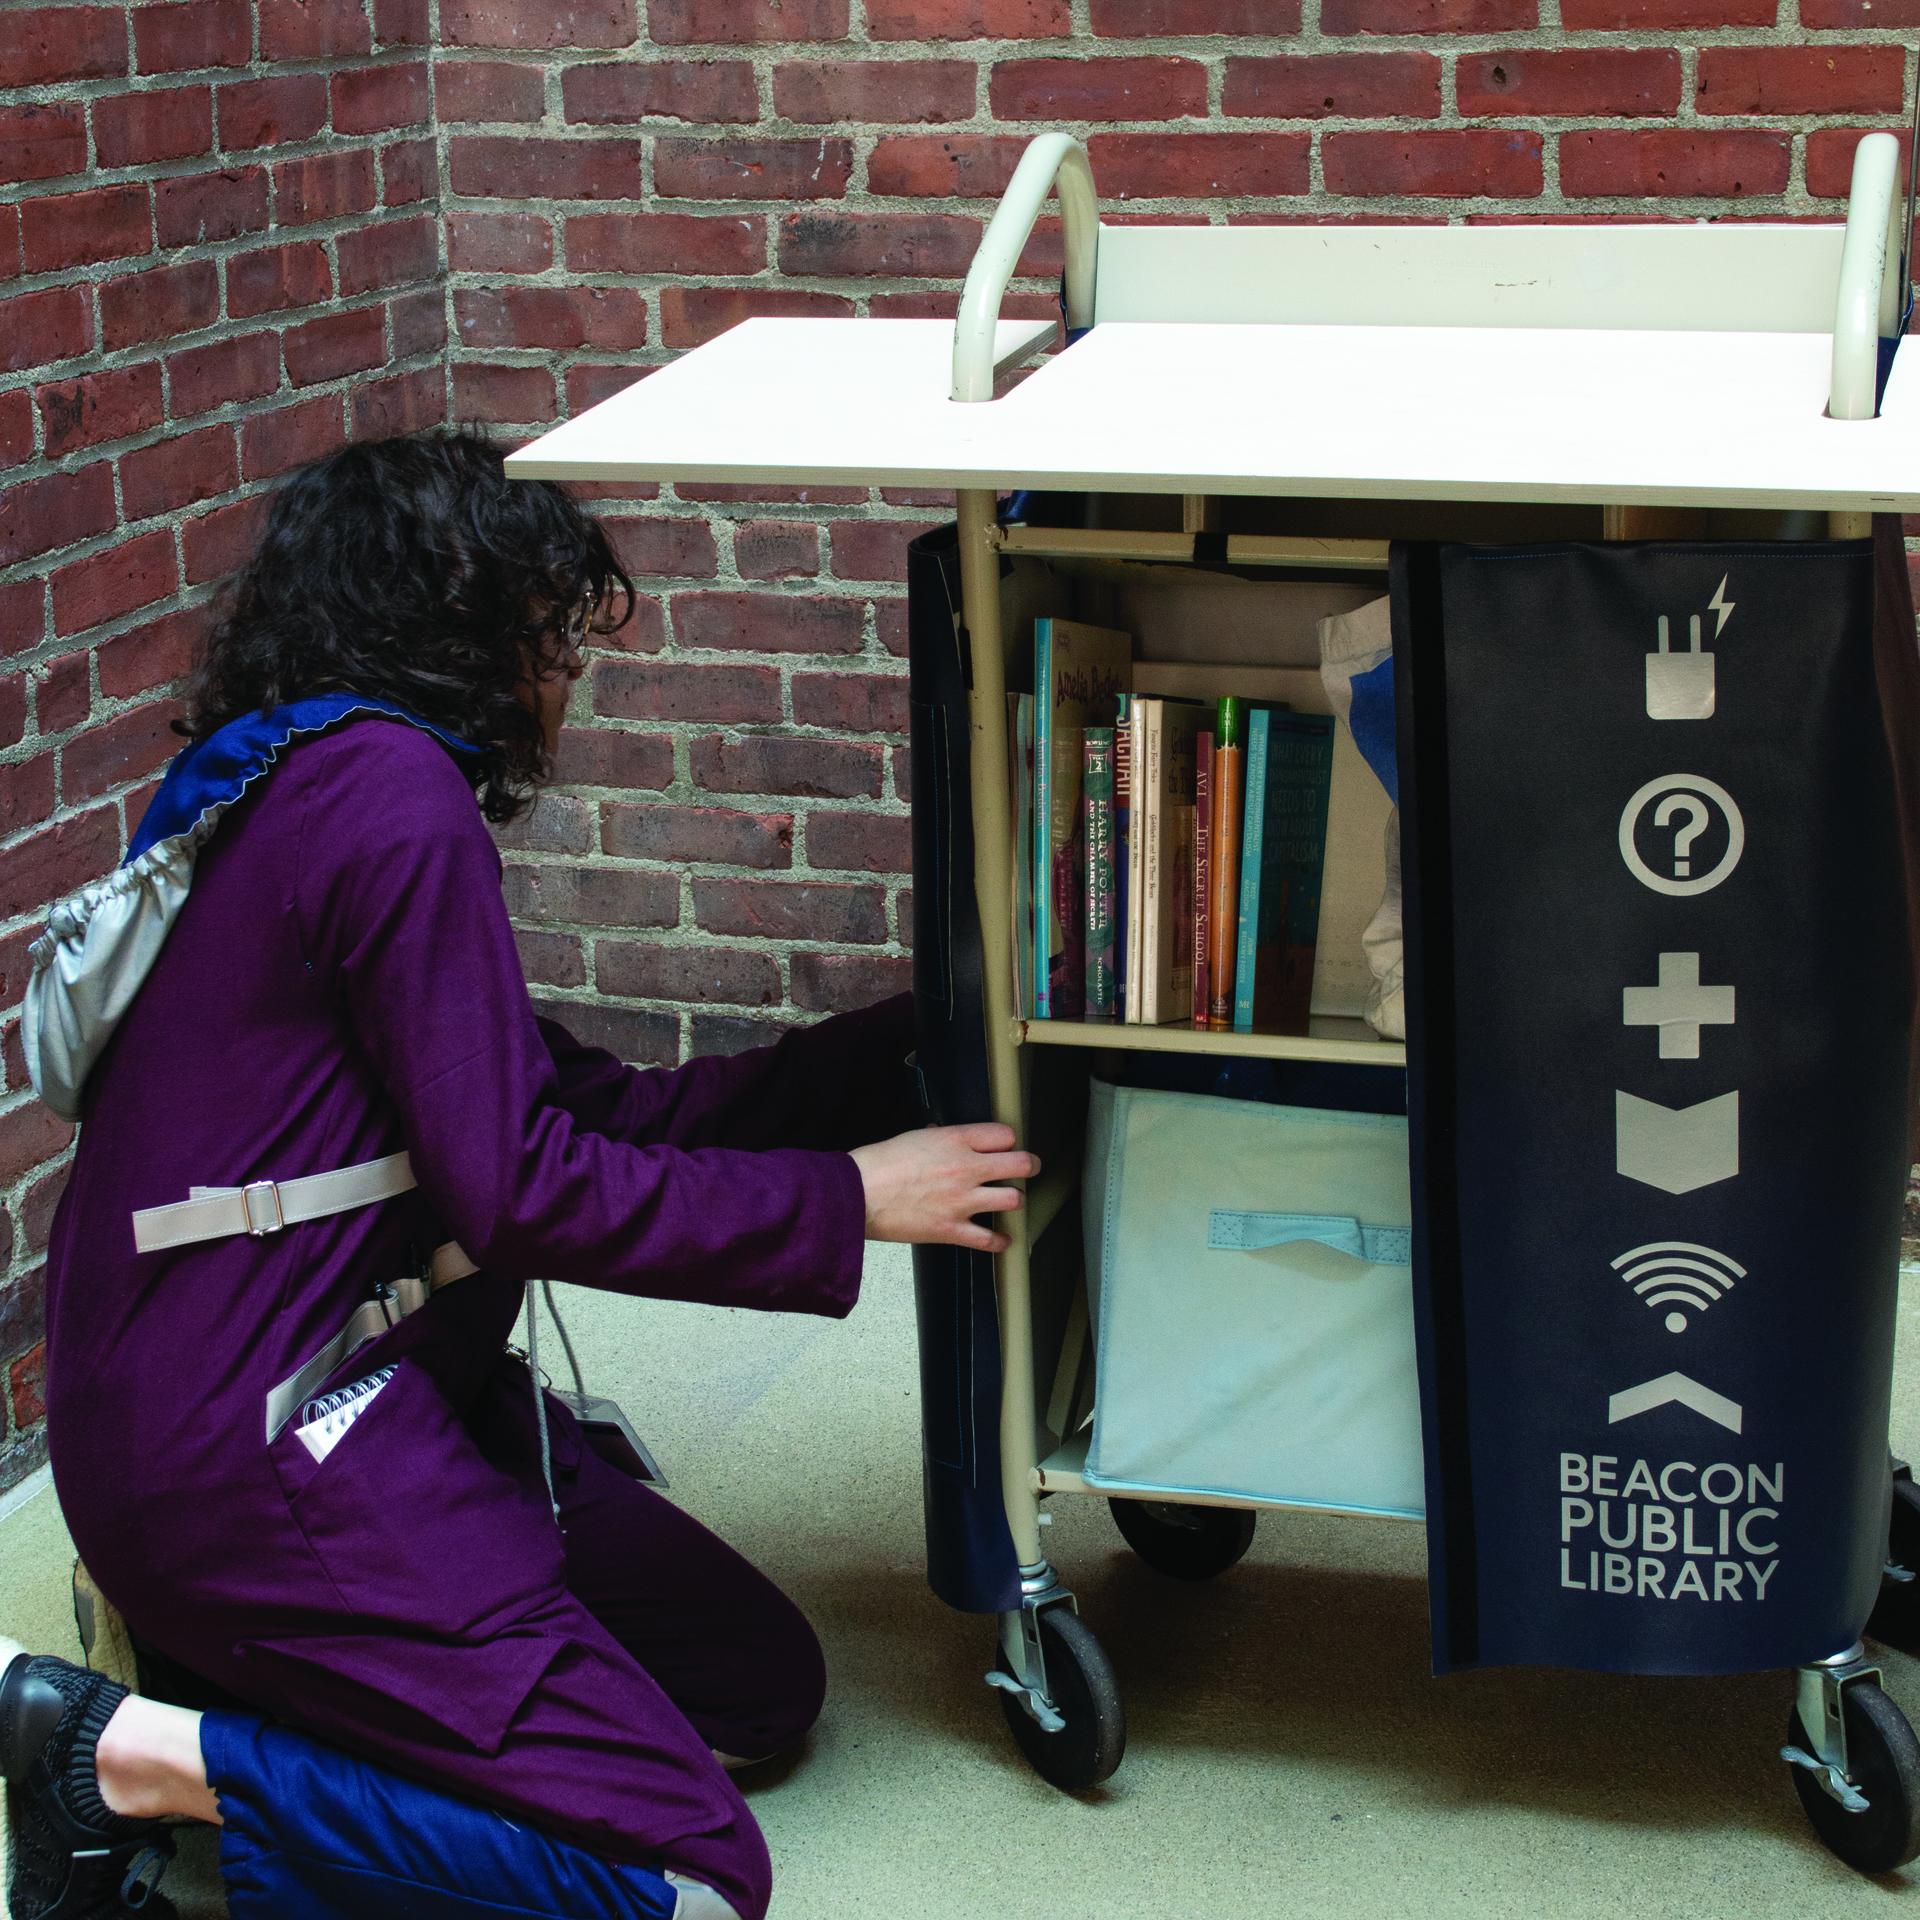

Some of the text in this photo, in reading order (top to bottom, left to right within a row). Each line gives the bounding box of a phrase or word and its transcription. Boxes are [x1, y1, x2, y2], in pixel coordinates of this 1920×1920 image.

[1095, 760, 1102, 771] 2
[1197, 770, 1207, 796] AVI
[1098, 800, 1108, 930] HARRY POTTER
[1089, 886, 1096, 897] OF
[1195, 826, 1208, 965] THE SECRET SCHOOL
[1560, 1452, 1784, 1504] BEACON
[1561, 1496, 1780, 1555] PUBLIC
[1561, 1548, 1780, 1601] LIBRARY
